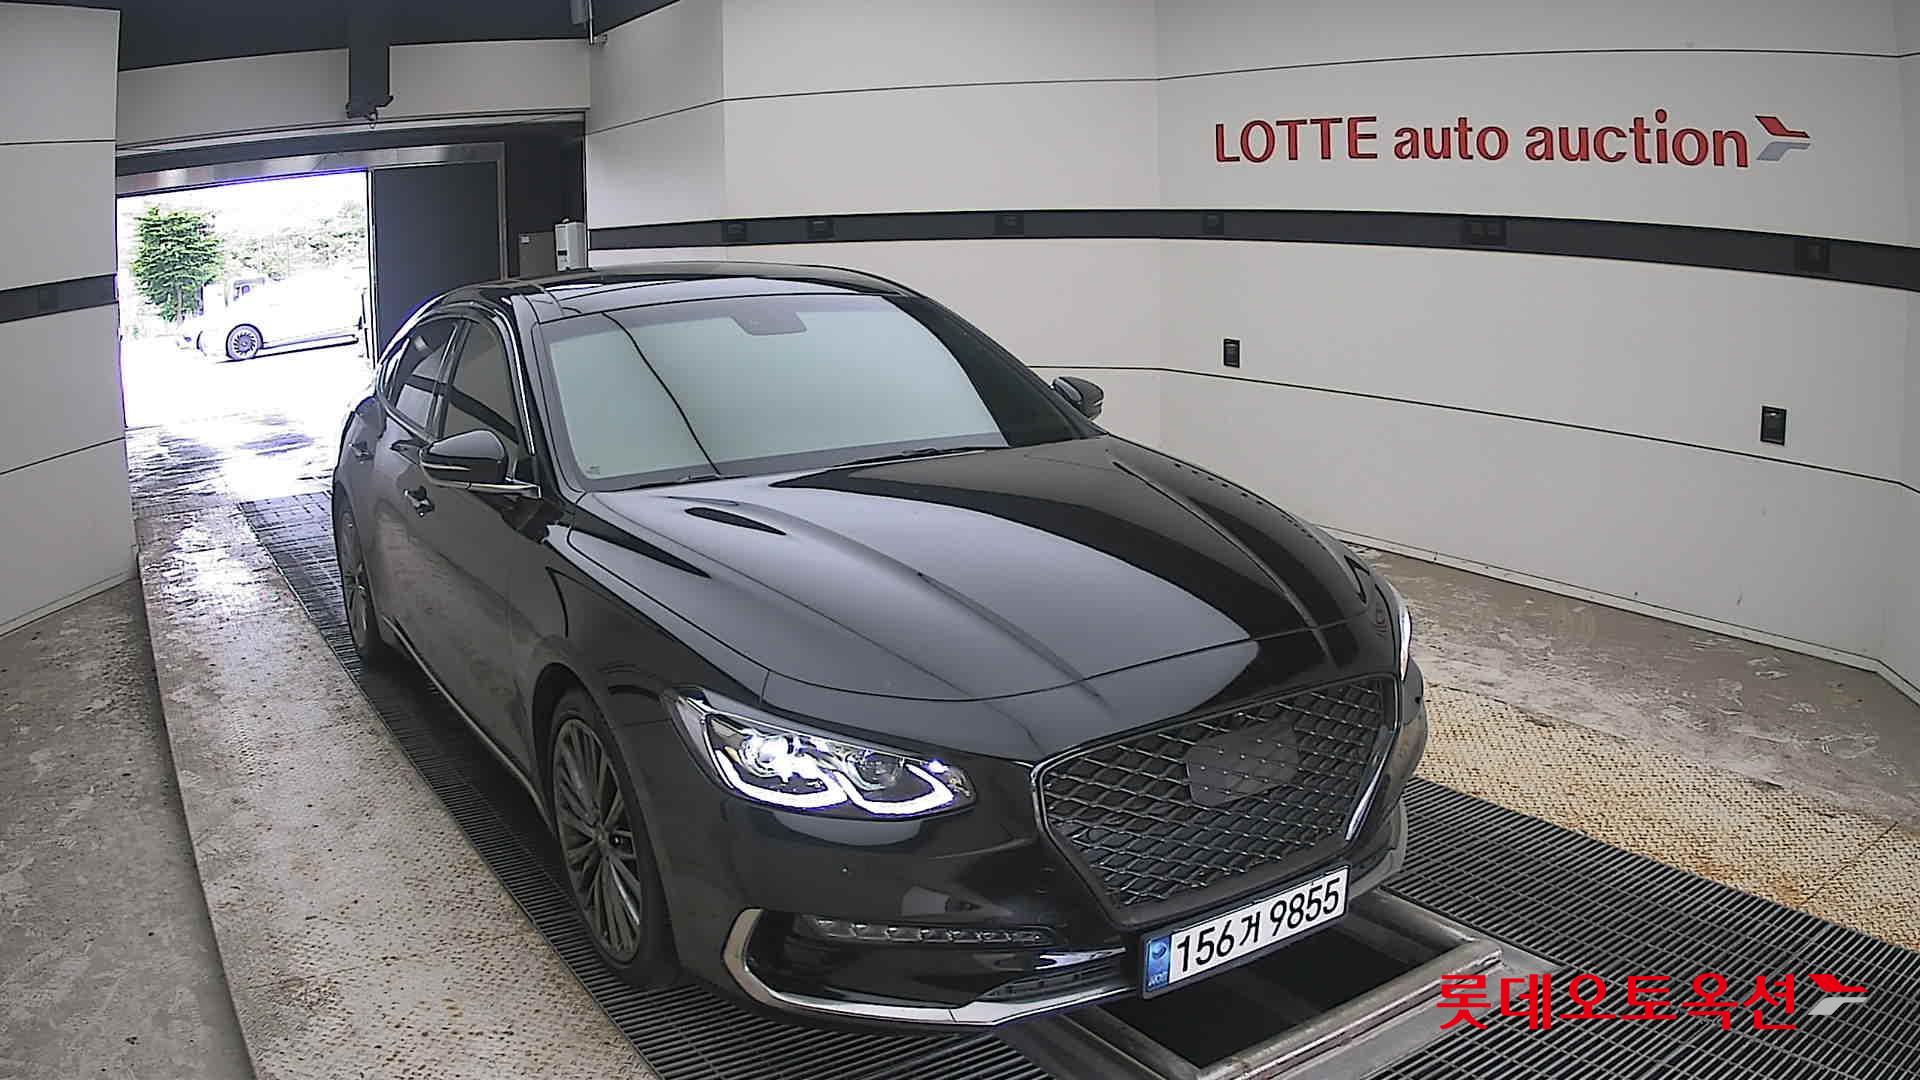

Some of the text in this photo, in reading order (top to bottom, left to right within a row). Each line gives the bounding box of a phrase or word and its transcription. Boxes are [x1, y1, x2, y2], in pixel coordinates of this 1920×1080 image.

[1215, 109, 1750, 168] LOTTE auto auction
[1269, 877, 1341, 937] 9855
